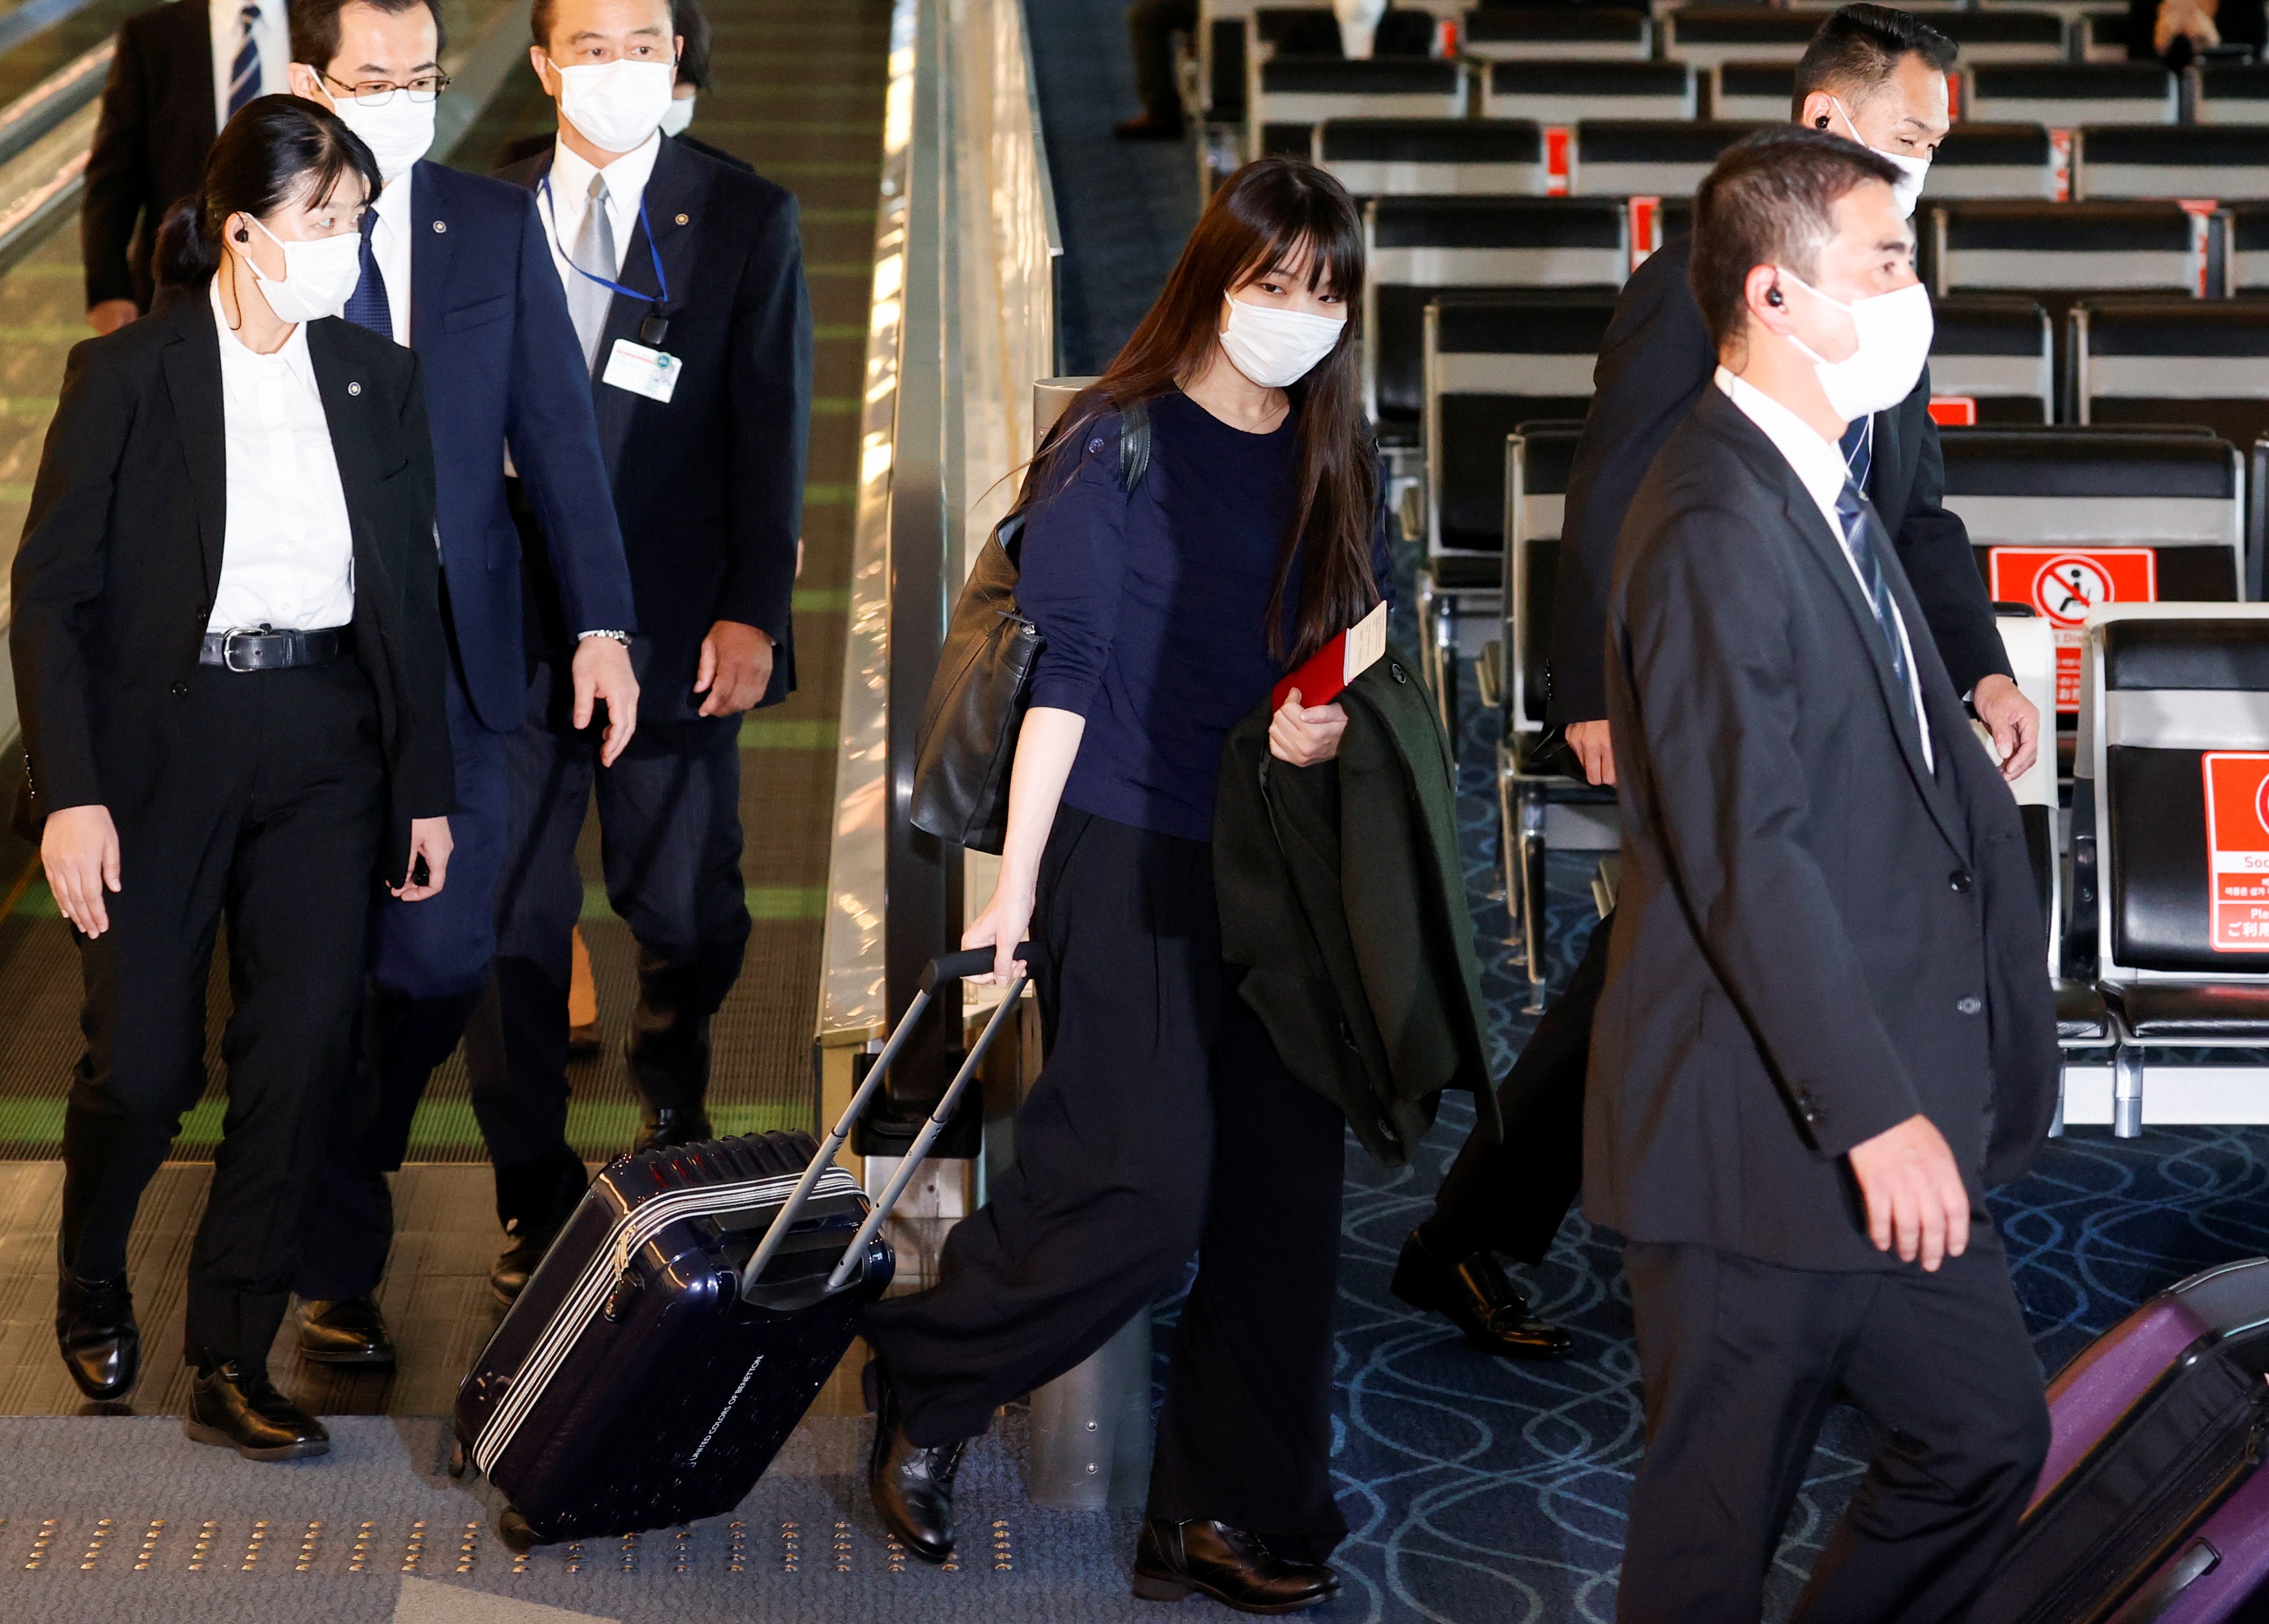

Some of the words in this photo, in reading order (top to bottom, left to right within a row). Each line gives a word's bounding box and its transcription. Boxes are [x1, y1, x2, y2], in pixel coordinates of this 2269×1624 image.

[689, 1436, 711, 1460] UNITED
[709, 1406, 731, 1434] COLORS
[729, 1395, 738, 1405] OF
